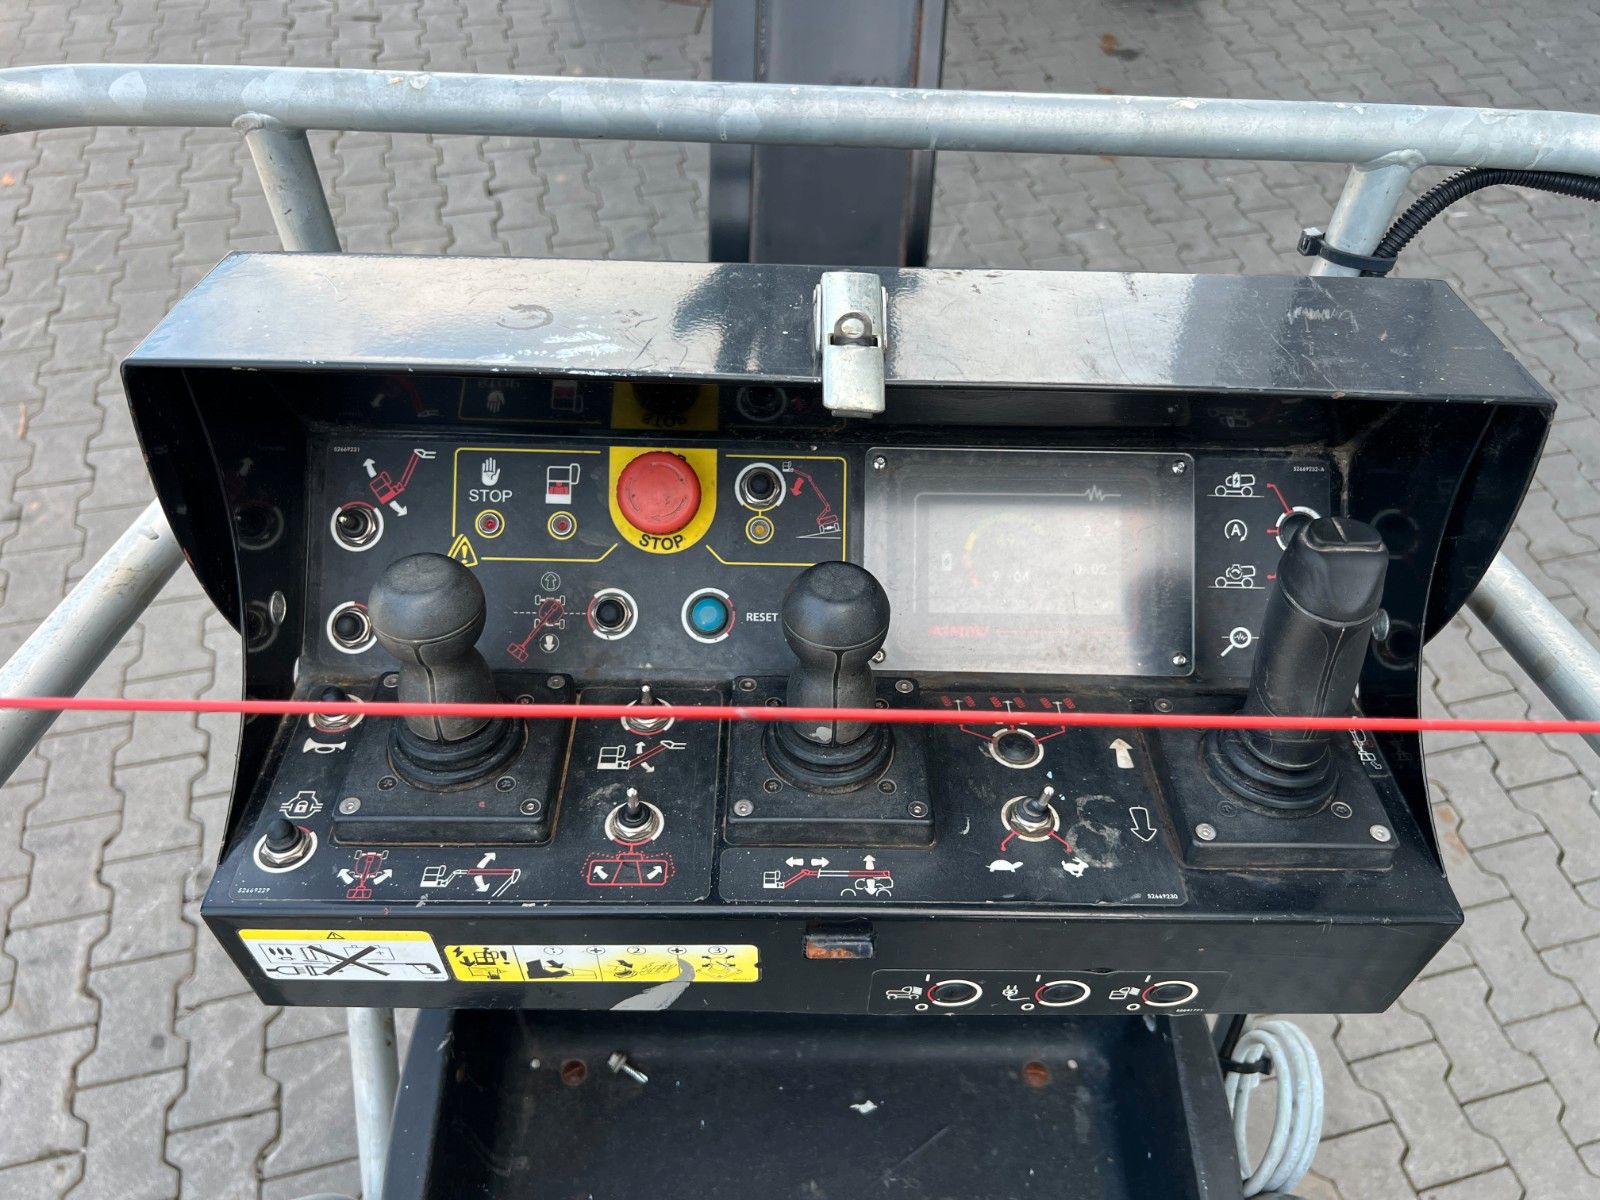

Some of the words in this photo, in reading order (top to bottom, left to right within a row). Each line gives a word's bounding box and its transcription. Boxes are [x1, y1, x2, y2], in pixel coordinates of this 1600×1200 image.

[469, 488, 513, 503] STOP
[1230, 523, 1241, 536] A
[639, 533, 684, 551] STOP
[746, 612, 779, 622] RESET
